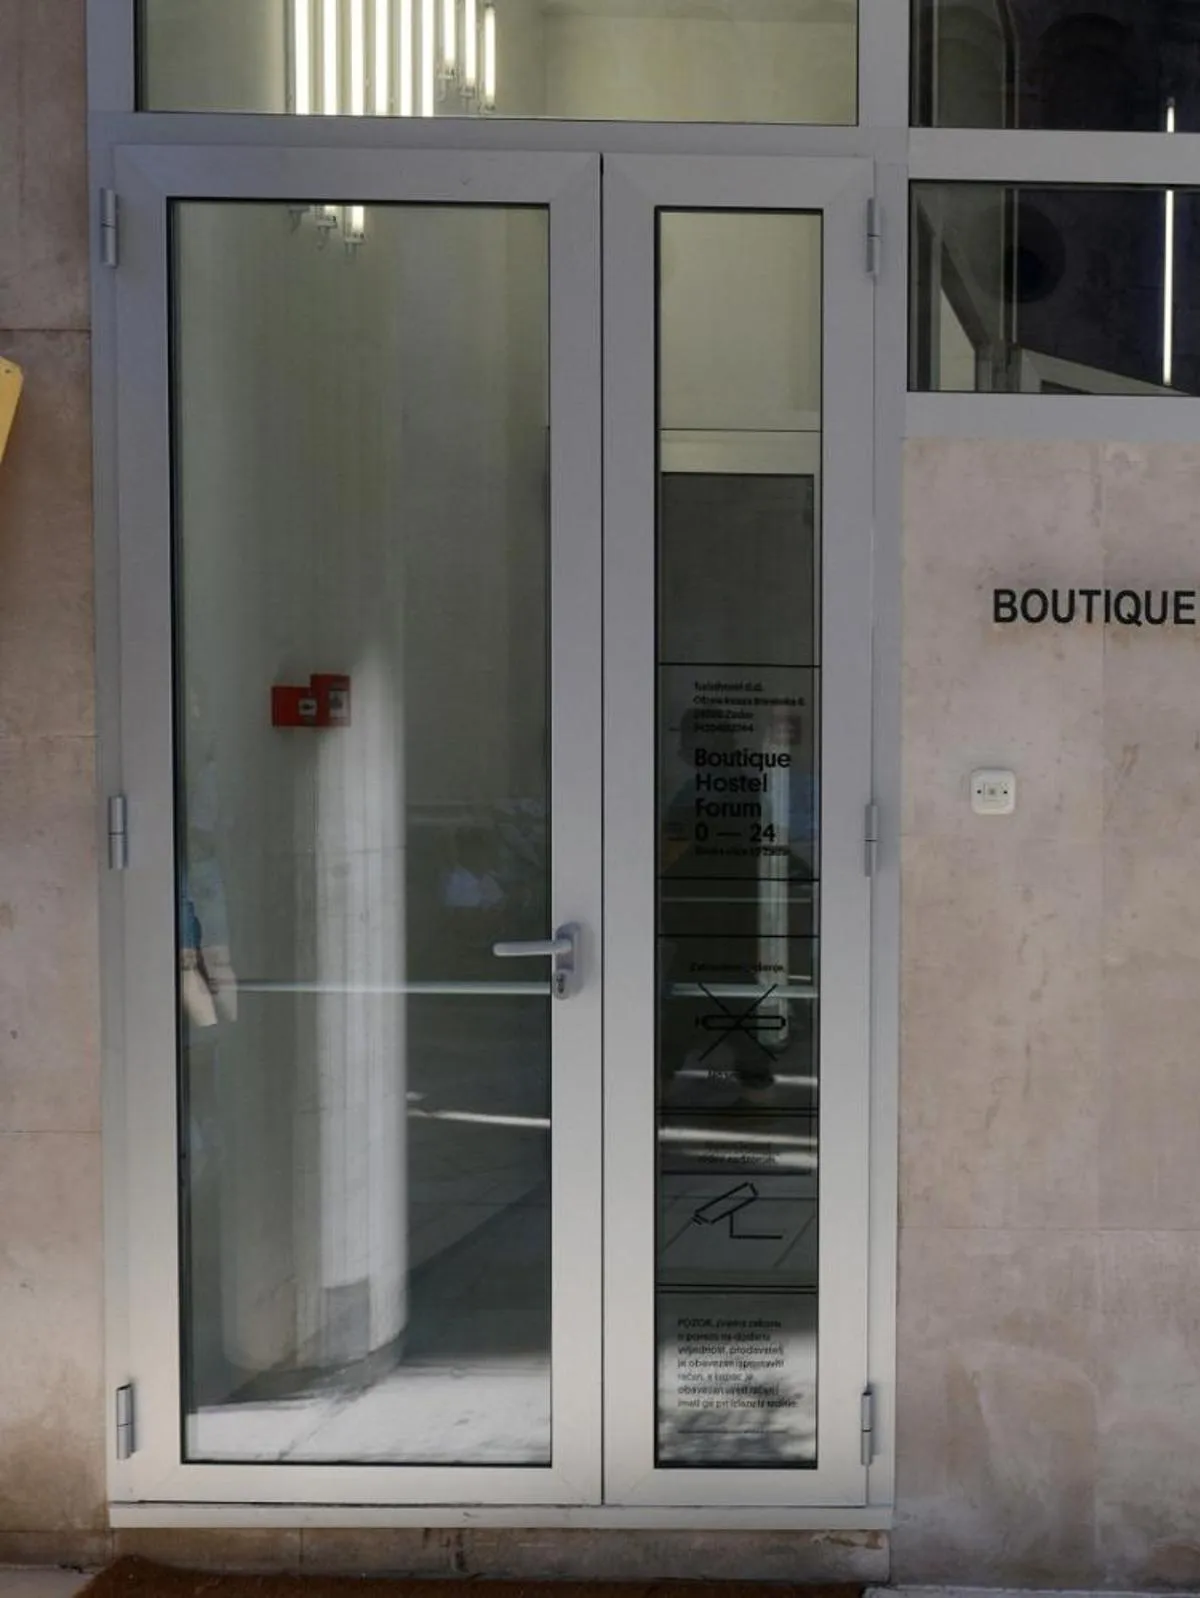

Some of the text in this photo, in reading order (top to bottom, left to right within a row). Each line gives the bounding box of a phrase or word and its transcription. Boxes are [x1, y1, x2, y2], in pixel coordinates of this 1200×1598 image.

[993, 588, 1196, 627] BOUTIQUE
[694, 748, 792, 771] Boutique
[695, 773, 768, 793] Hostel
[695, 798, 762, 818] Forum
[694, 822, 708, 843] 0
[750, 823, 776, 843] 24
